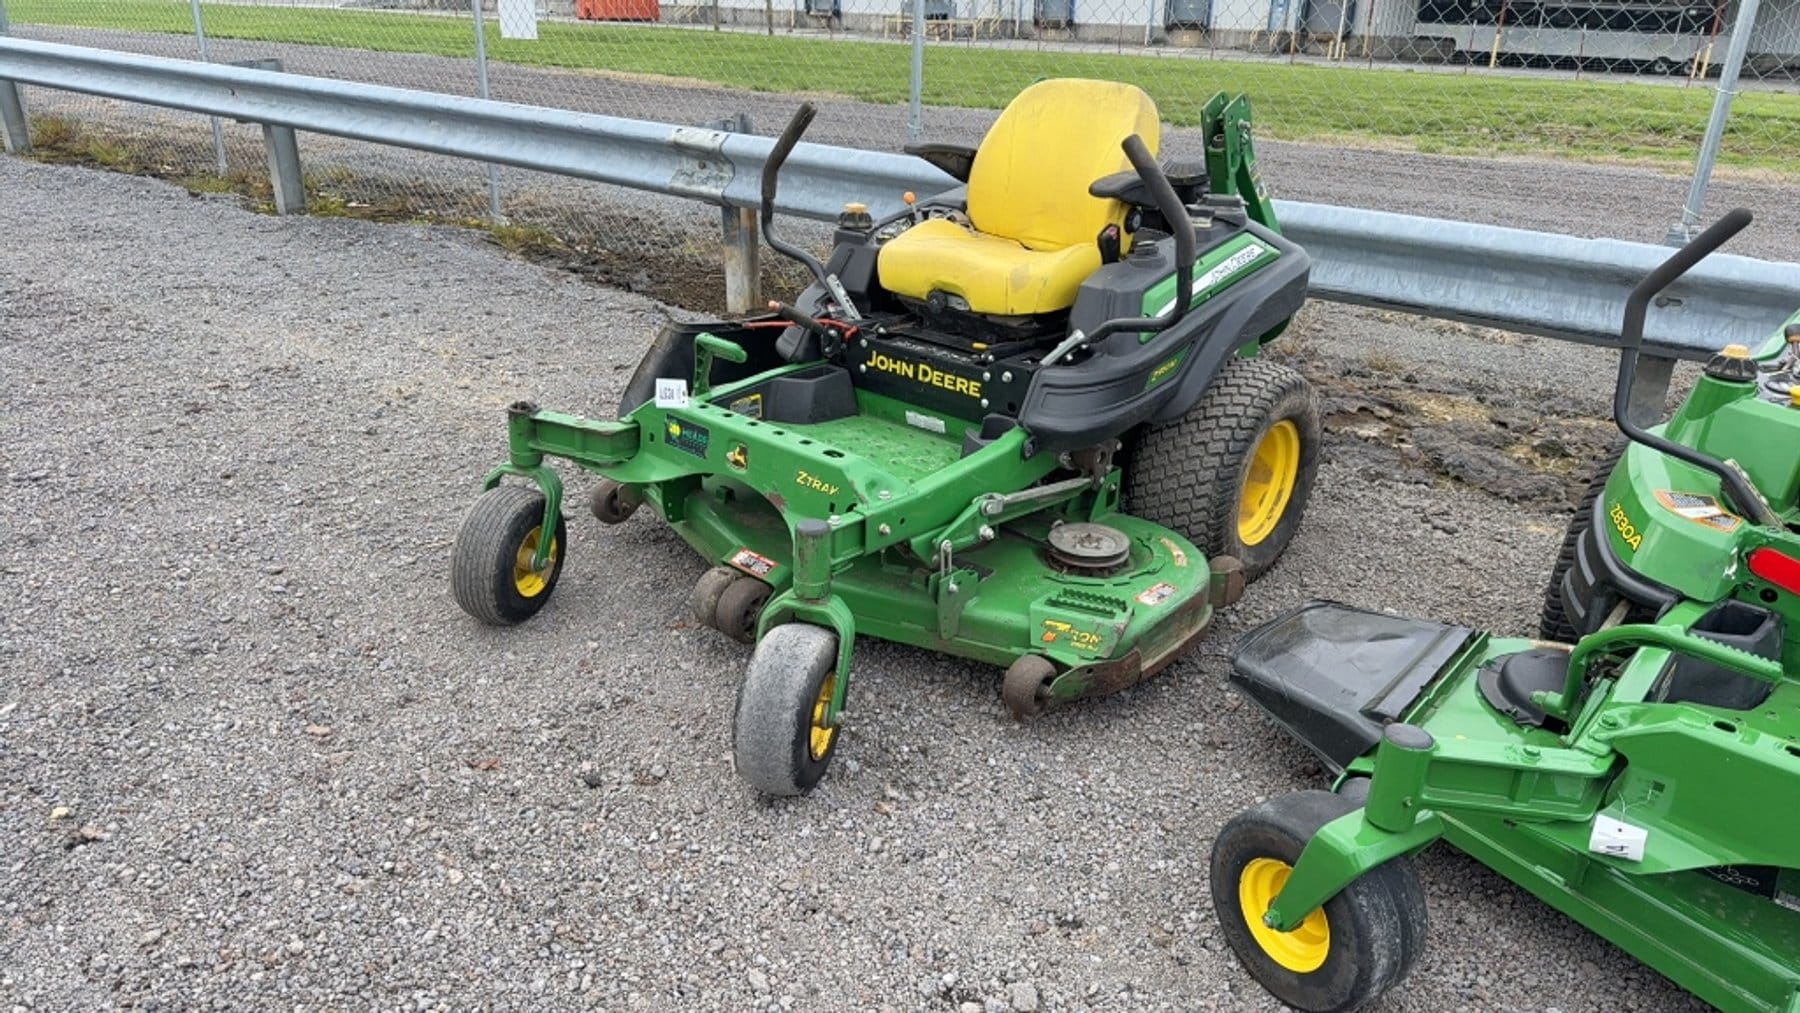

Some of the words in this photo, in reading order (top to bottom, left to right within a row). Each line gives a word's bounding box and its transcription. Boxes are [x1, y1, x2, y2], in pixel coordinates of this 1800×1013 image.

[866, 350, 914, 379] JOHN
[917, 363, 982, 398] DEERE
[796, 470, 840, 496] ZTRAY
